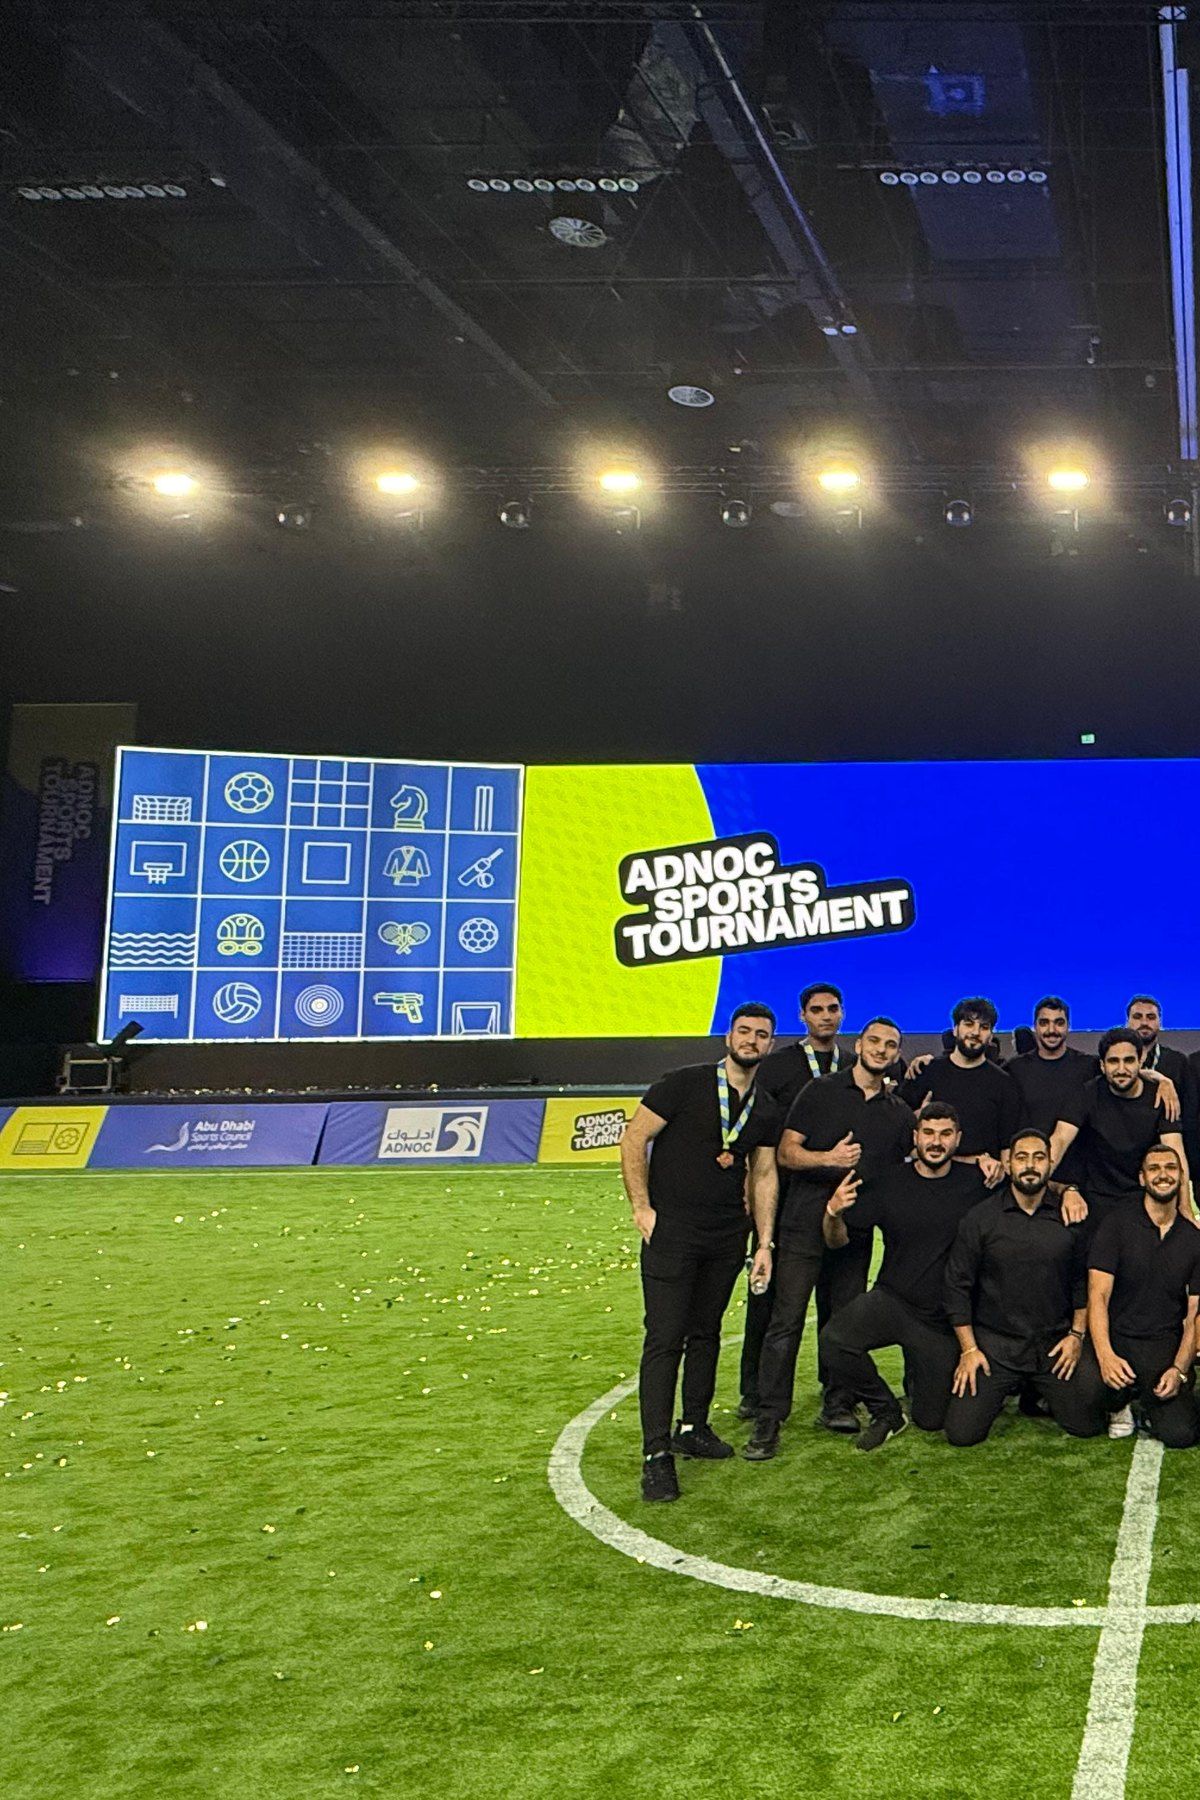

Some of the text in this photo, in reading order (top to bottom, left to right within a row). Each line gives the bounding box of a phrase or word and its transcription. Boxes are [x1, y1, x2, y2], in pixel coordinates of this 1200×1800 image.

[74, 765, 96, 839] ADNOC
[33, 763, 63, 905] TOURNAMENT
[54, 778, 76, 861] SPORTS
[625, 841, 775, 894] ADNOC
[653, 870, 820, 922] SPORTS
[623, 889, 908, 959] TOURNAMENT
[191, 1132, 252, 1142] Sports Council
[194, 1120, 256, 1132] Abu Dhabi
[576, 1112, 624, 1128] ADNOC
[584, 1122, 630, 1137] SPORT
[384, 1142, 432, 1153] ADNOC
[574, 1134, 624, 1149] TOURN
